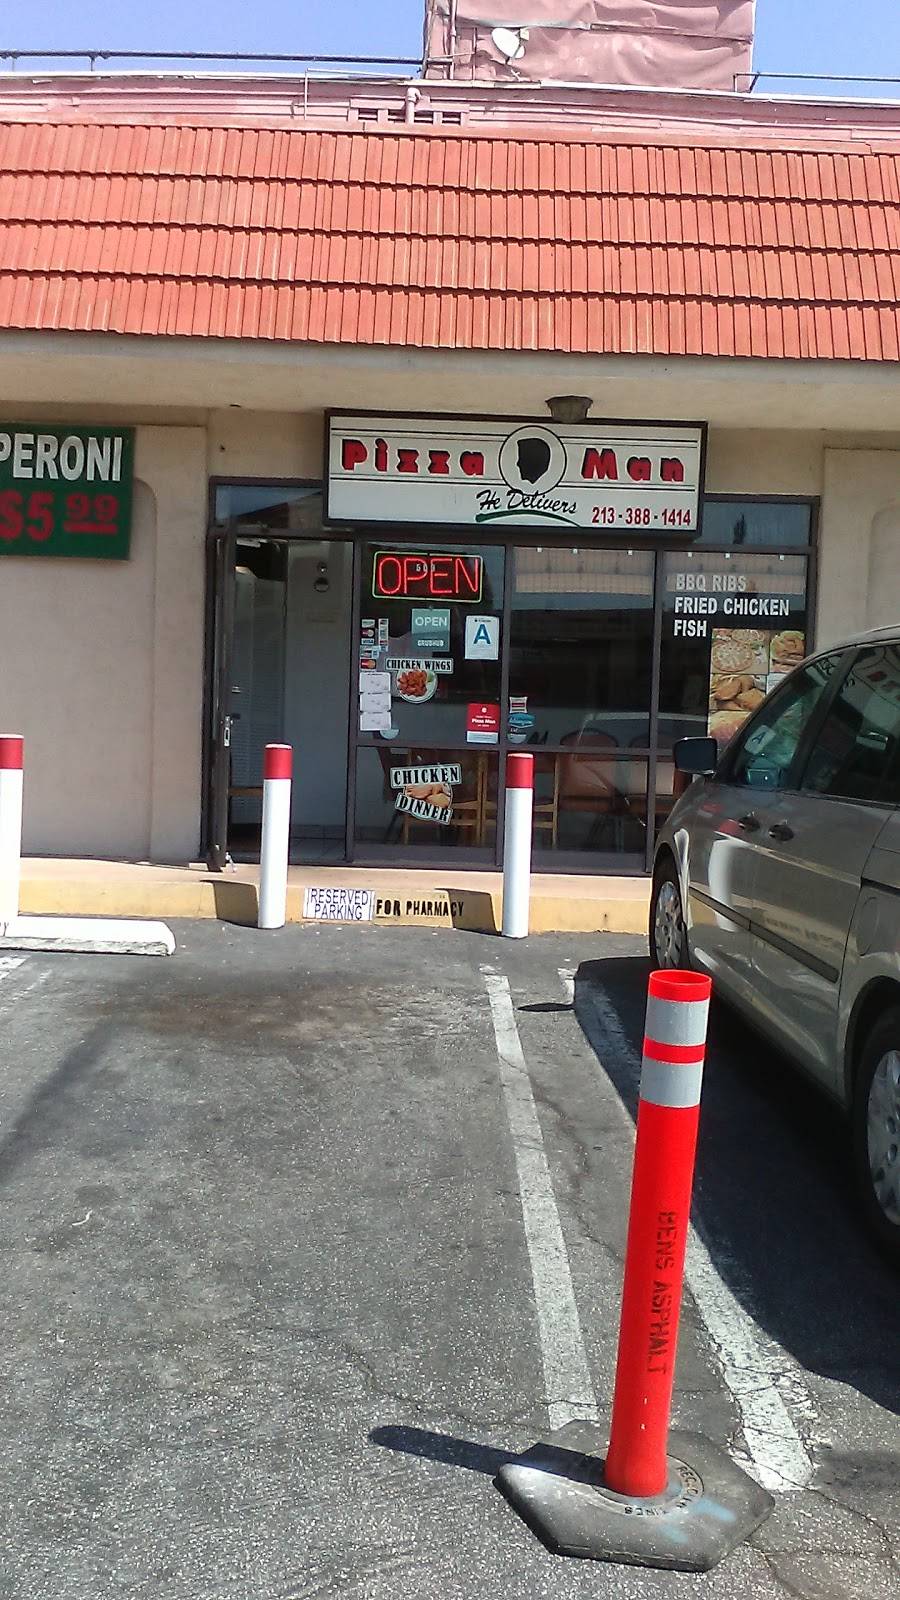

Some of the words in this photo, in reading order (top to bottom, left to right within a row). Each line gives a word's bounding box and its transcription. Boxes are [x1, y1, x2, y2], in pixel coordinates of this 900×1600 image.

[341, 438, 485, 476] Pizza
[581, 447, 685, 482] Man
[475, 489, 501, 511] He
[506, 488, 577, 514] Delivers
[378, 556, 479, 594] OPEN
[675, 573, 706, 592] BBQ
[712, 574, 747, 592] RIBS
[674, 596, 718, 614] FRIED
[723, 598, 790, 616] CHICKEN
[415, 616, 448, 627] OPEN
[673, 619, 707, 637] FISH
[473, 623, 491, 645] A
[386, 659, 421, 670] CHICKEN
[424, 660, 451, 671] WINGS
[393, 767, 459, 785] CHICKEN
[398, 795, 449, 822] DINNER
[310, 888, 368, 906] RESERVED
[314, 903, 363, 920] PARKING
[376, 899, 401, 917] FOR
[405, 900, 464, 917] PHARMACY
[656, 1211, 678, 1270] BENS
[647, 1280, 672, 1375] ASPHALT
